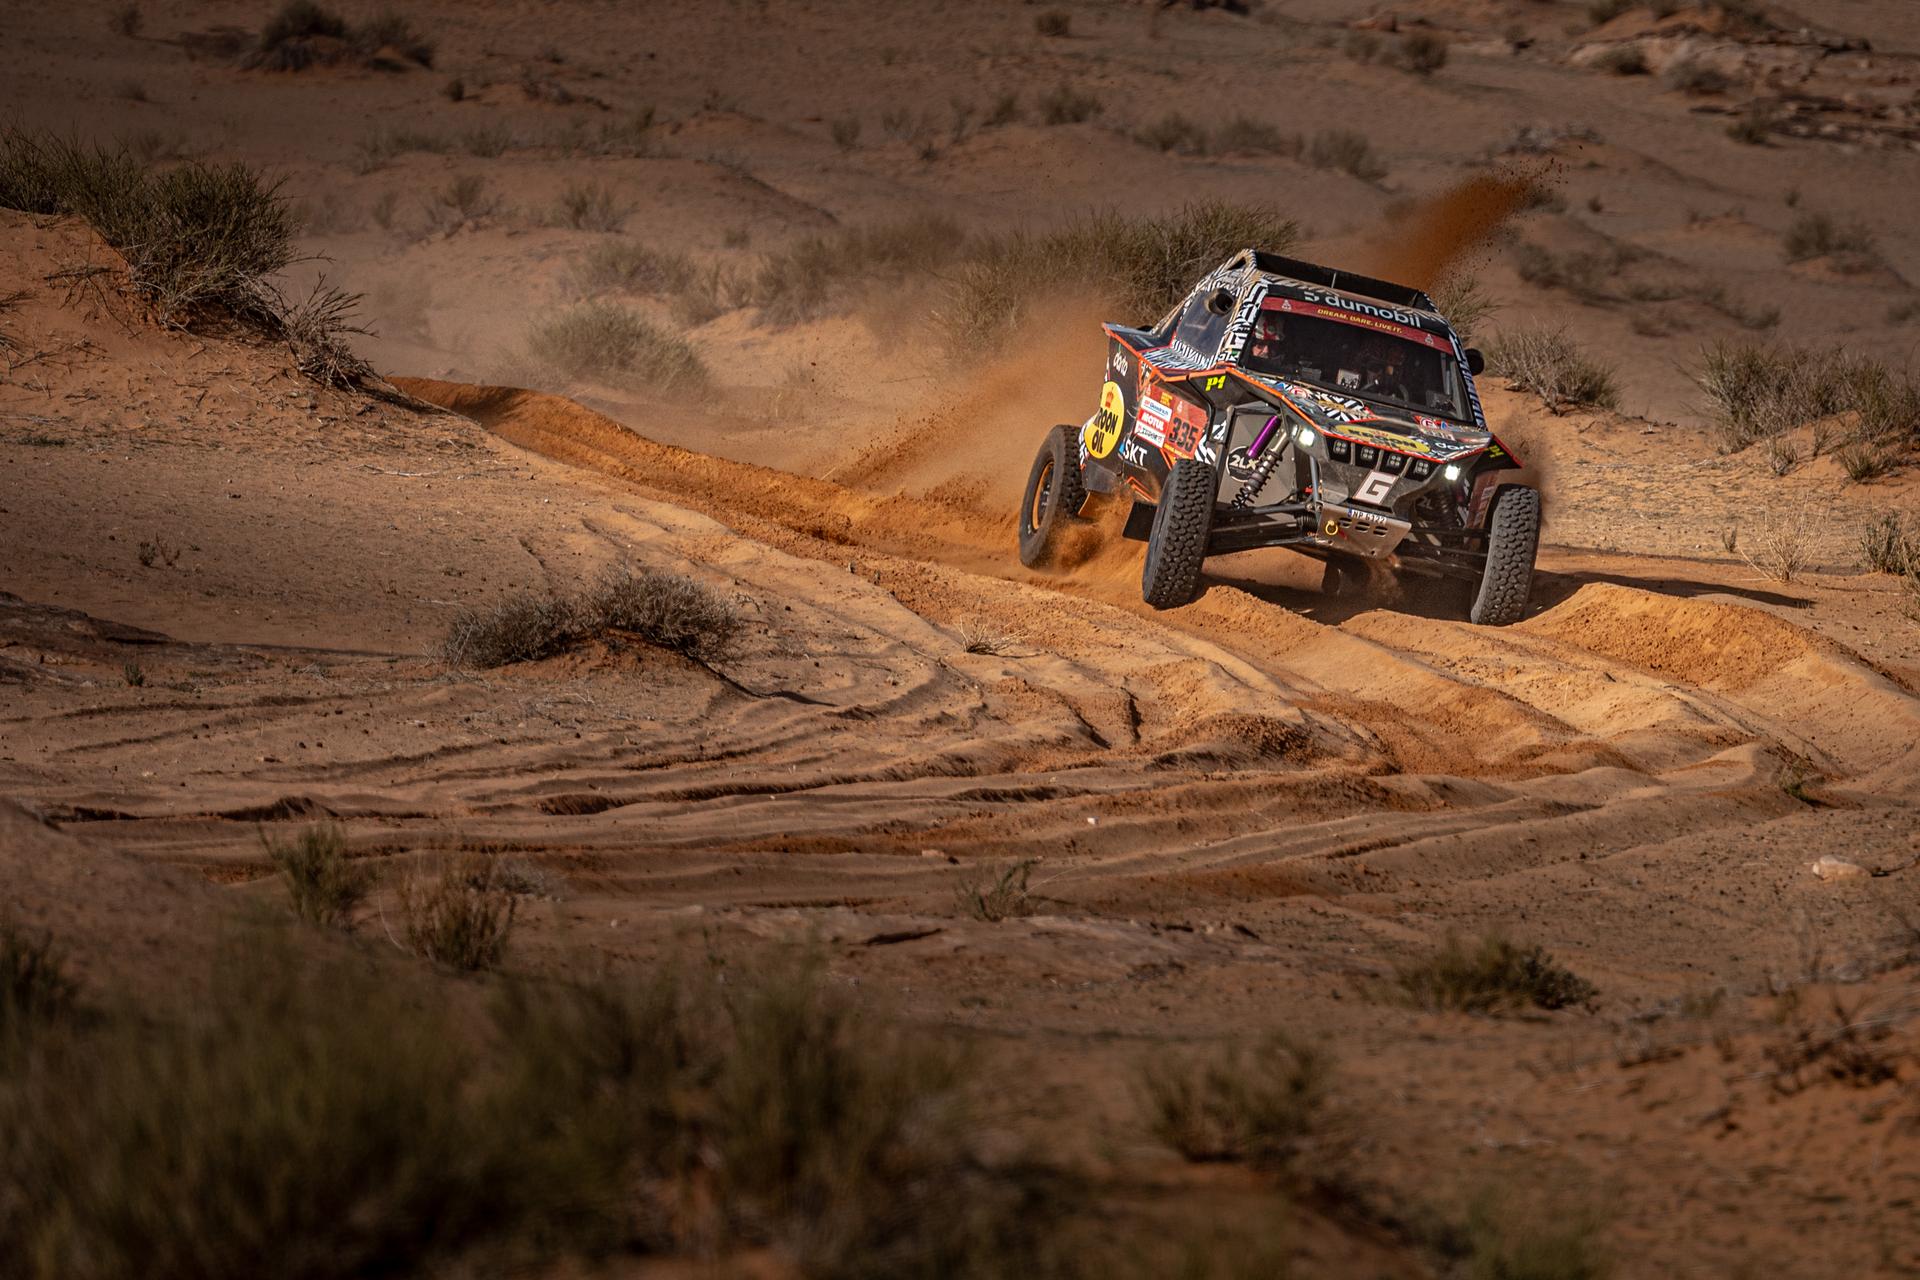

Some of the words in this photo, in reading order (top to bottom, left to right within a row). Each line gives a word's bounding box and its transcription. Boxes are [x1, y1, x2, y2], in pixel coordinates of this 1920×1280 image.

[1317, 308, 1348, 320] DREAM.
[1349, 315, 1373, 326] DARE.
[1374, 321, 1392, 331] LIVE
[1392, 325, 1403, 334] IT.
[1325, 293, 1421, 328] dumobil
[1205, 375, 1226, 391] P1
[1096, 407, 1119, 435] ROON
[1168, 416, 1199, 453] 335
[1091, 428, 1105, 454] OIL
[1123, 438, 1148, 467] SKT
